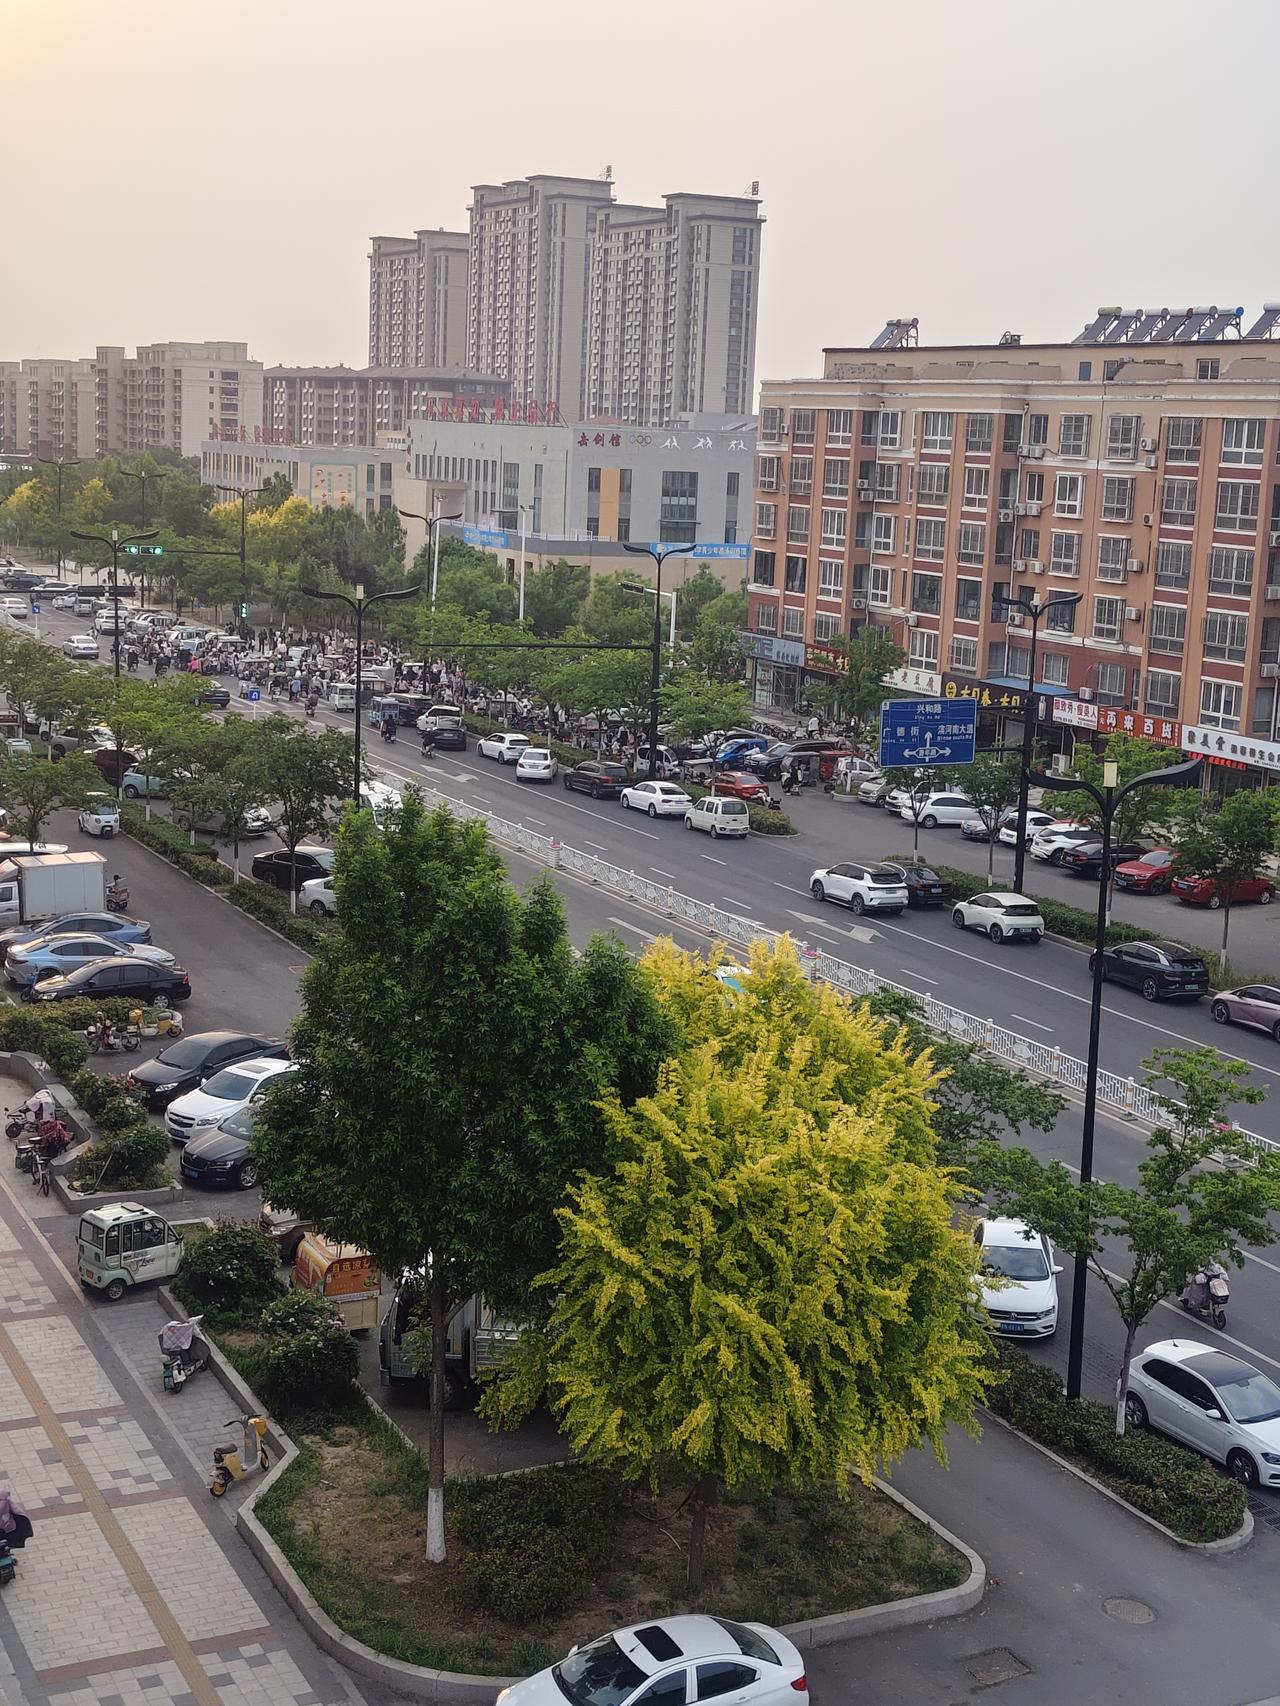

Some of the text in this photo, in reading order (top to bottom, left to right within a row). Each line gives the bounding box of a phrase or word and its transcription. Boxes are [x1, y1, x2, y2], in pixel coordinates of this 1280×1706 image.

[916, 703, 942, 714] 兴和路
[937, 723, 974, 735] 滨河南大道
[918, 749, 937, 757] 青年路
